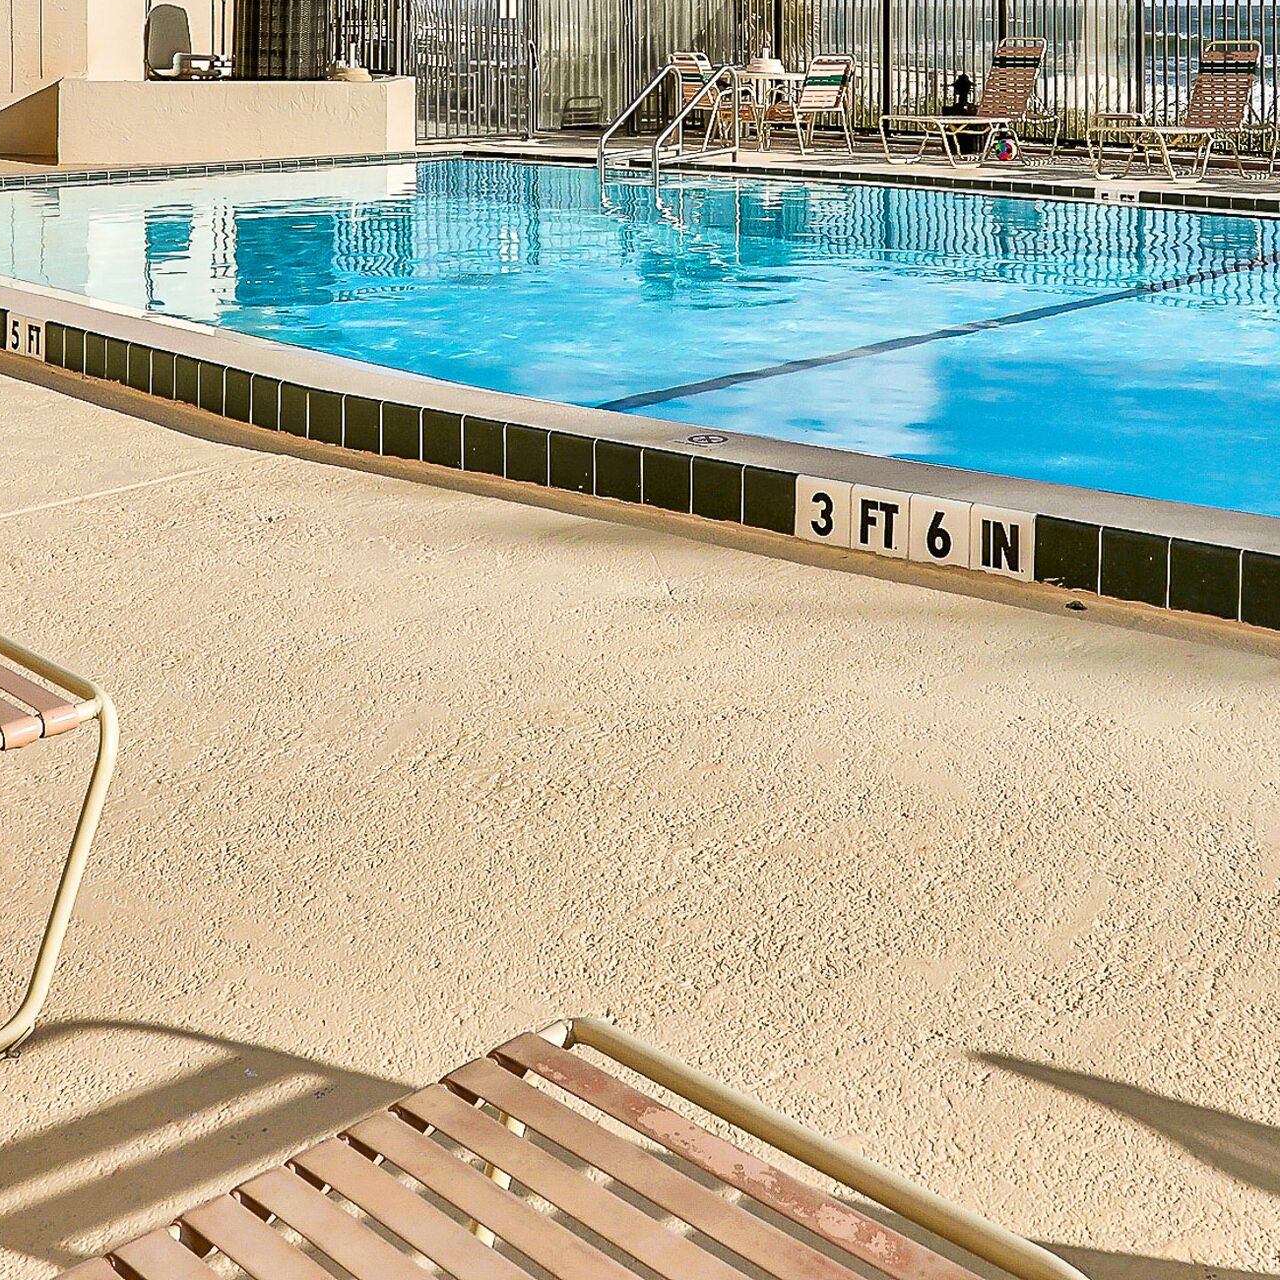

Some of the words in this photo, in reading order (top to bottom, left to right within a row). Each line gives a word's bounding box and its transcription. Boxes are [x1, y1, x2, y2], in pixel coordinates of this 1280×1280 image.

[11, 319, 19, 350] 5
[27, 323, 41, 355] FT
[810, 492, 834, 537] 3
[926, 510, 952, 559] 6
